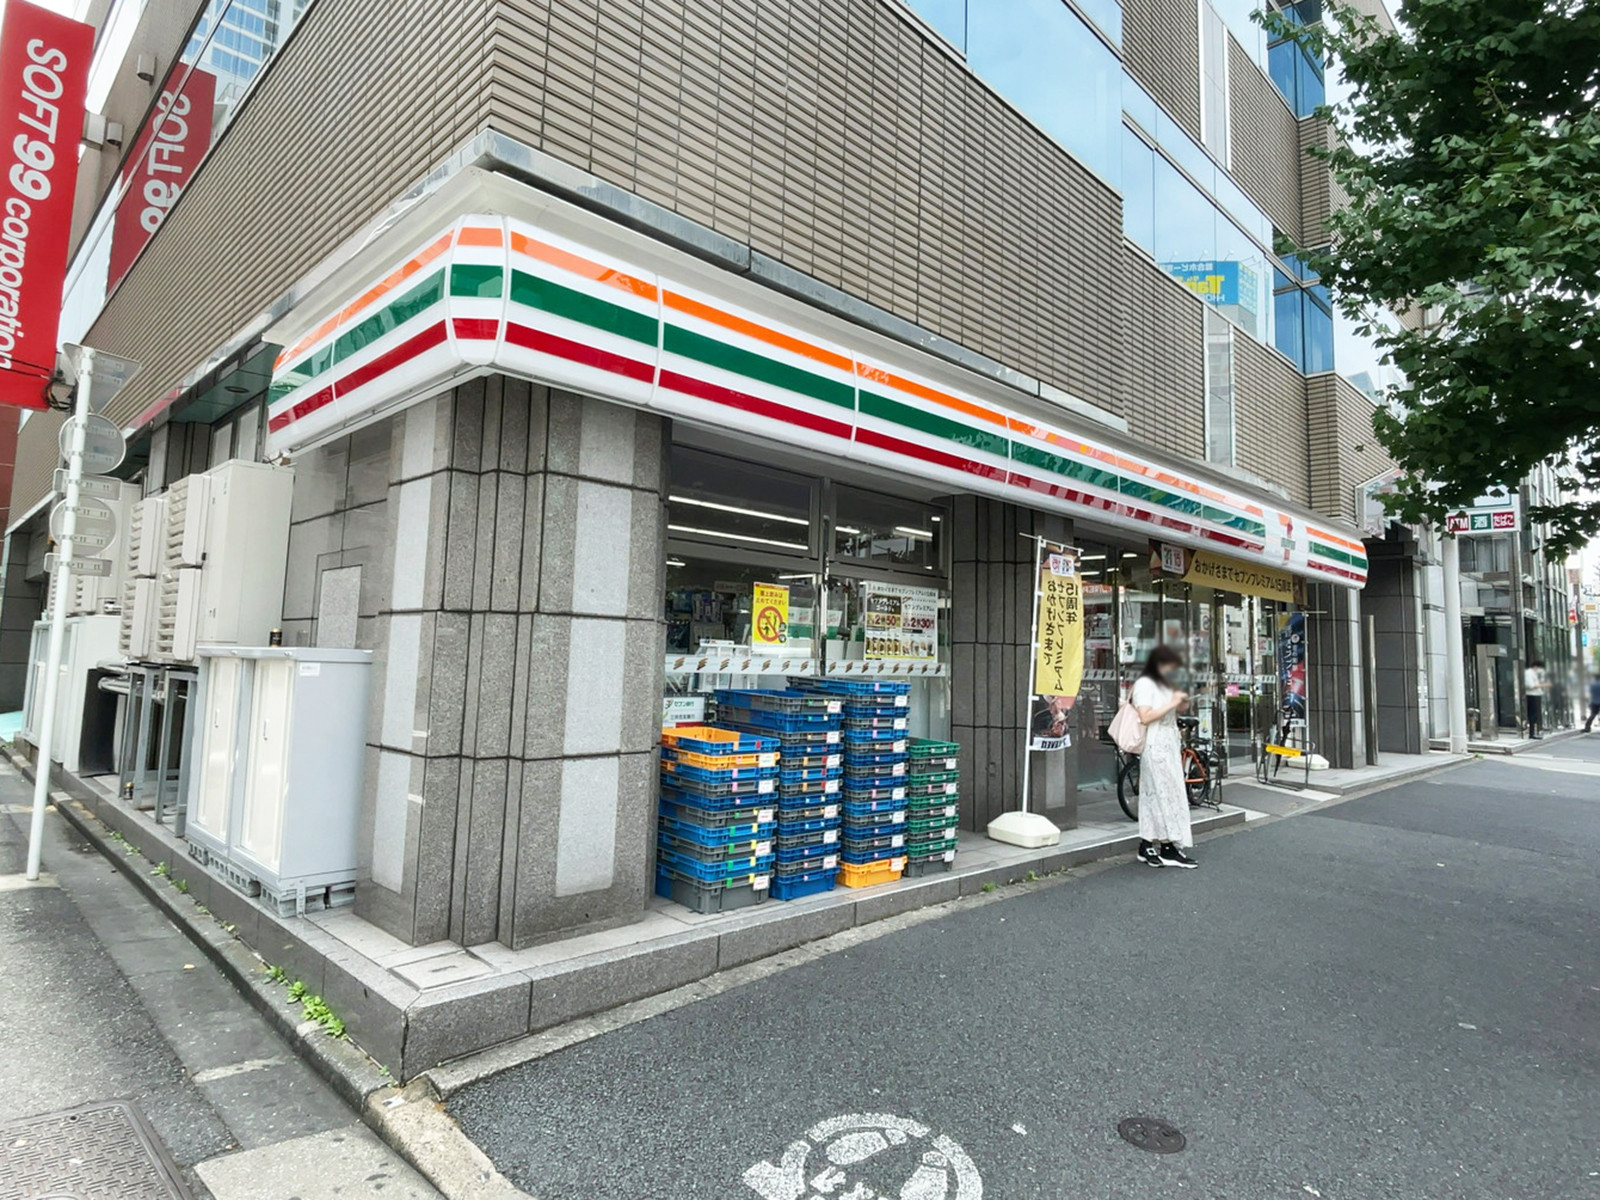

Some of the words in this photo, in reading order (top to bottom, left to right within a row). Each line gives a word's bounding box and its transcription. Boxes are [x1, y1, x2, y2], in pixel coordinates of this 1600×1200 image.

[0, 194, 32, 370] corporation
[1474, 516, 1488, 529] 酒
[1493, 514, 1514, 527] たばこ
